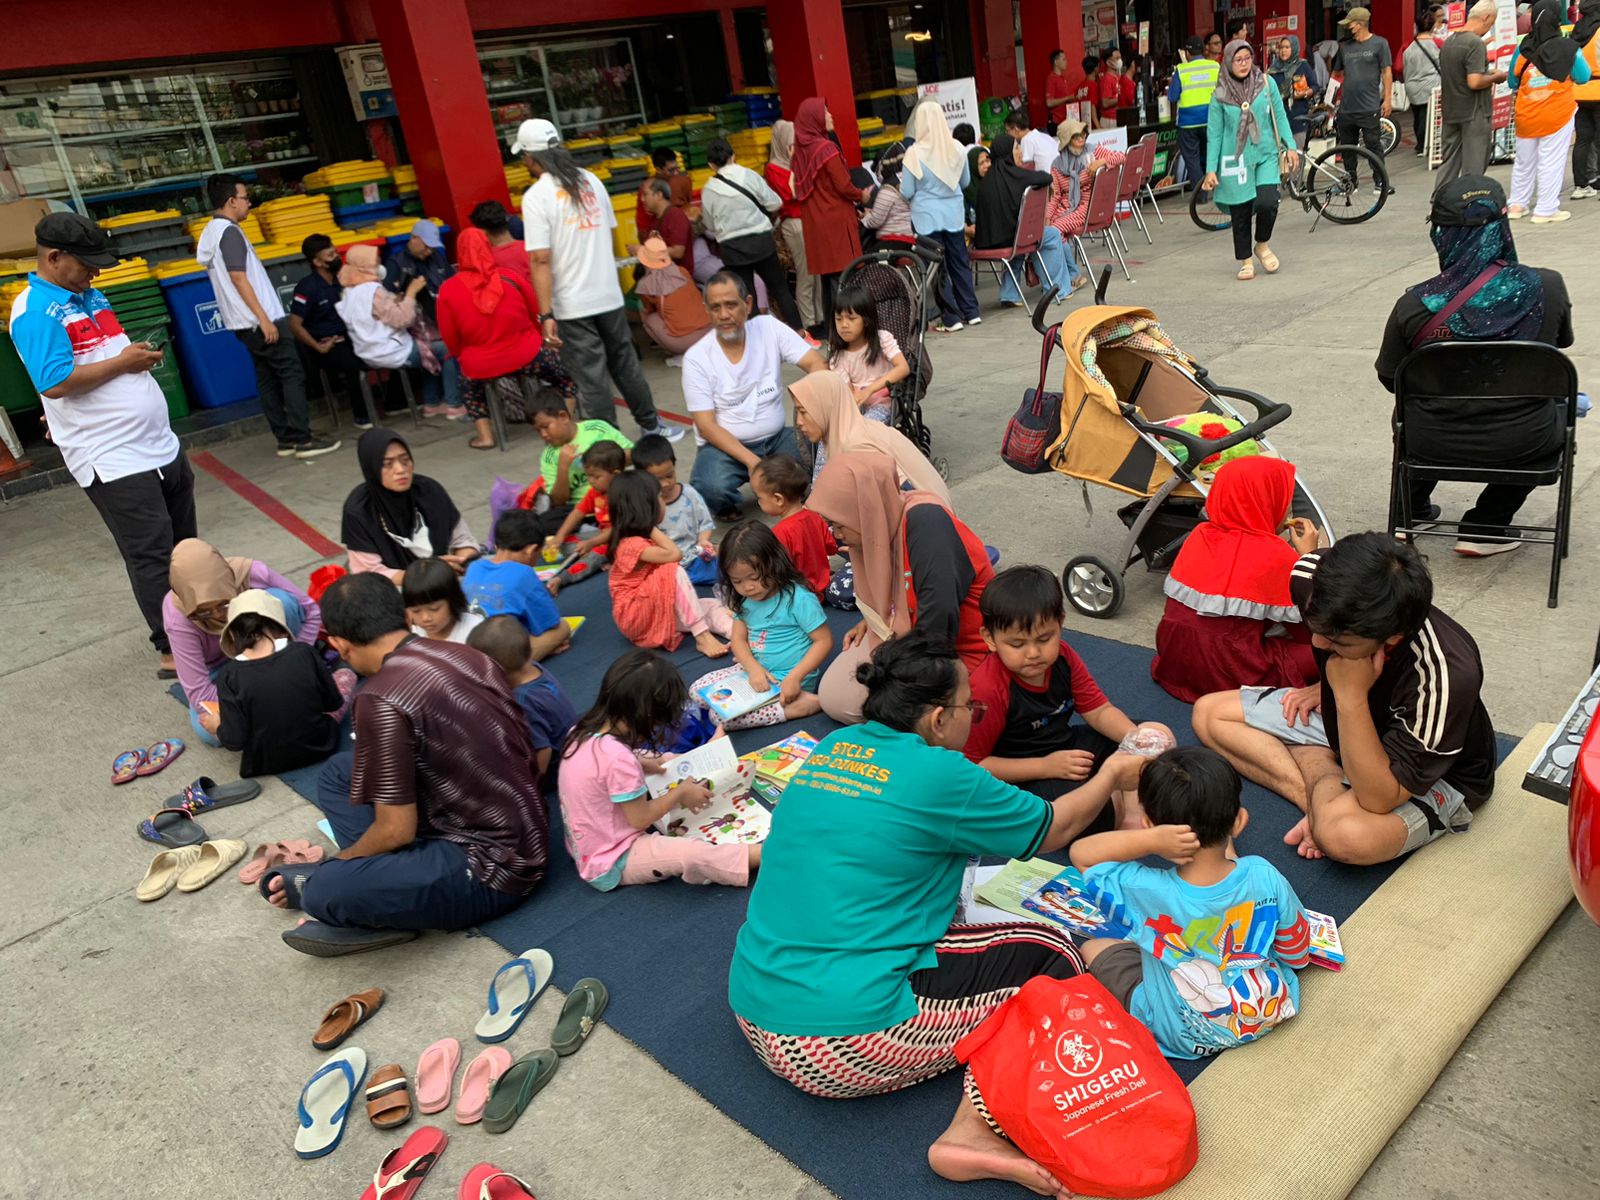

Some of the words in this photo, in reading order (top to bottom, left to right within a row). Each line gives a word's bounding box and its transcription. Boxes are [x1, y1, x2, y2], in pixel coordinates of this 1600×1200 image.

[831, 742, 876, 759] BTCLS
[829, 758, 892, 782] DINKES
[1053, 1060, 1139, 1111] SHIGERU
[1063, 1098, 1105, 1122] Japanese
[1105, 1086, 1130, 1103] Fresh
[1129, 1077, 1147, 1091] Deli
